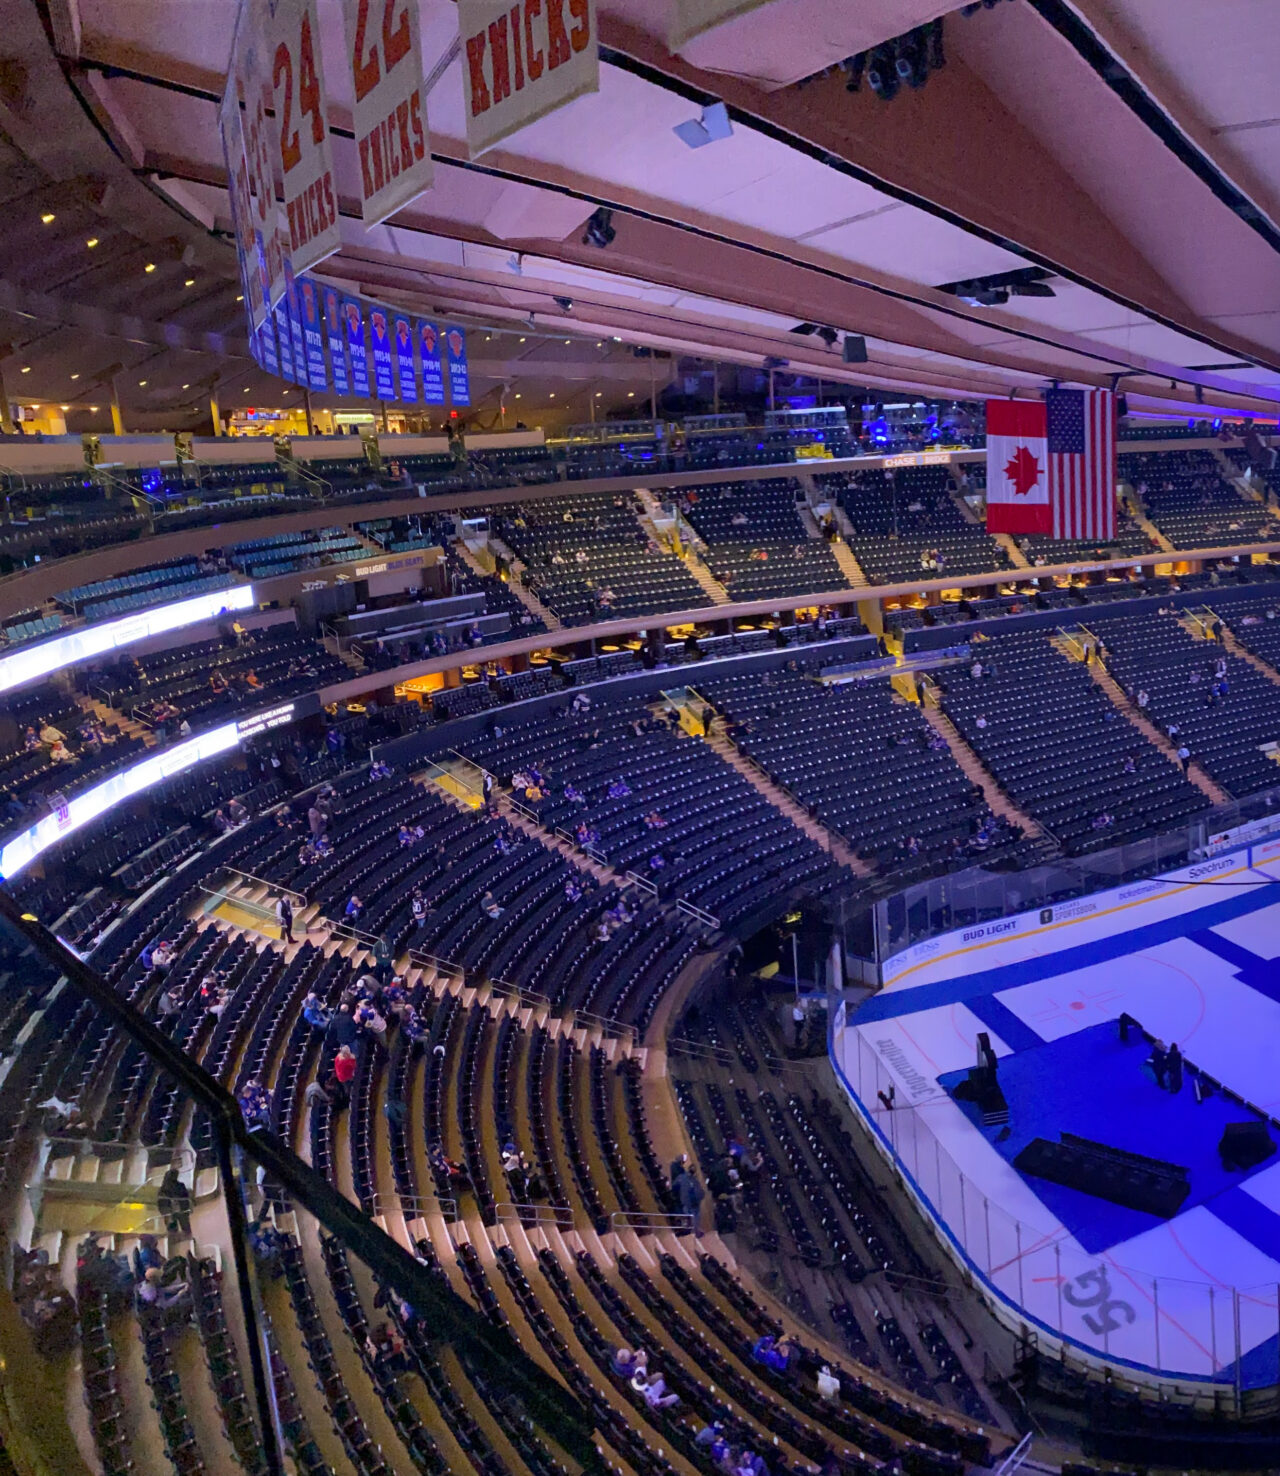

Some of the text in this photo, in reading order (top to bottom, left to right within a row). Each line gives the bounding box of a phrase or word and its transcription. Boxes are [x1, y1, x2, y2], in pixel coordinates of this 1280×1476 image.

[272, 8, 325, 173] 24
[466, 0, 590, 117] KNICKS
[358, 88, 424, 199] KNICKS
[286, 170, 336, 252] KNICKS
[356, 567, 369, 577] BUD
[369, 563, 388, 574] LIGHT
[1189, 858, 1234, 879] Spectrum
[963, 920, 1017, 941] BUD LIGHT
[1054, 903, 1097, 921] SPORTSBOOK
[1062, 1269, 1137, 1336] 5G
